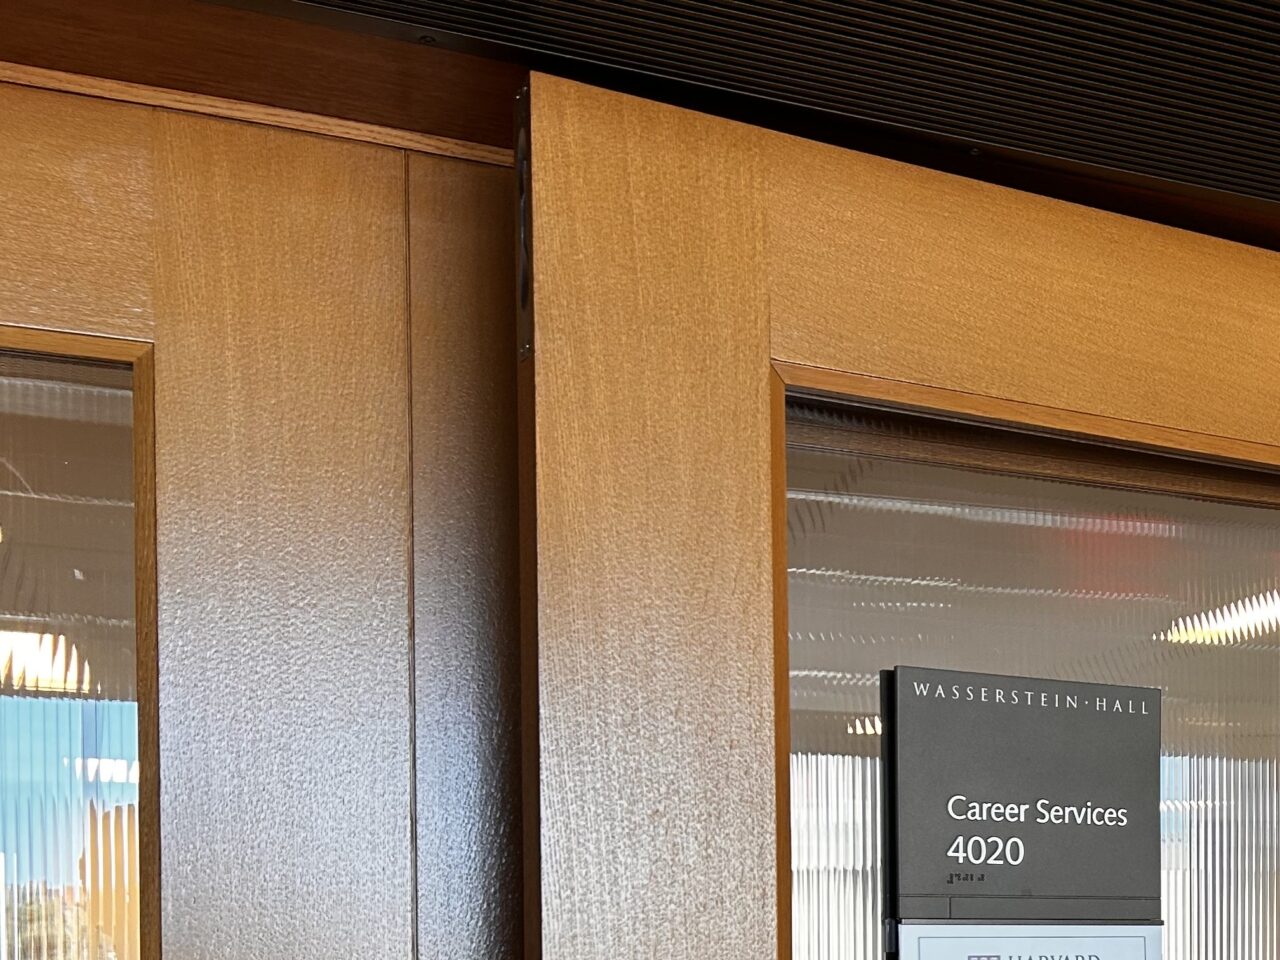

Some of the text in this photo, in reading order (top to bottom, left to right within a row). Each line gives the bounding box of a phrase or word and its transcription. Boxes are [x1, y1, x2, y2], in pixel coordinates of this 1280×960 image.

[947, 795, 1128, 826] Career Services
[946, 835, 1025, 866] 4020
